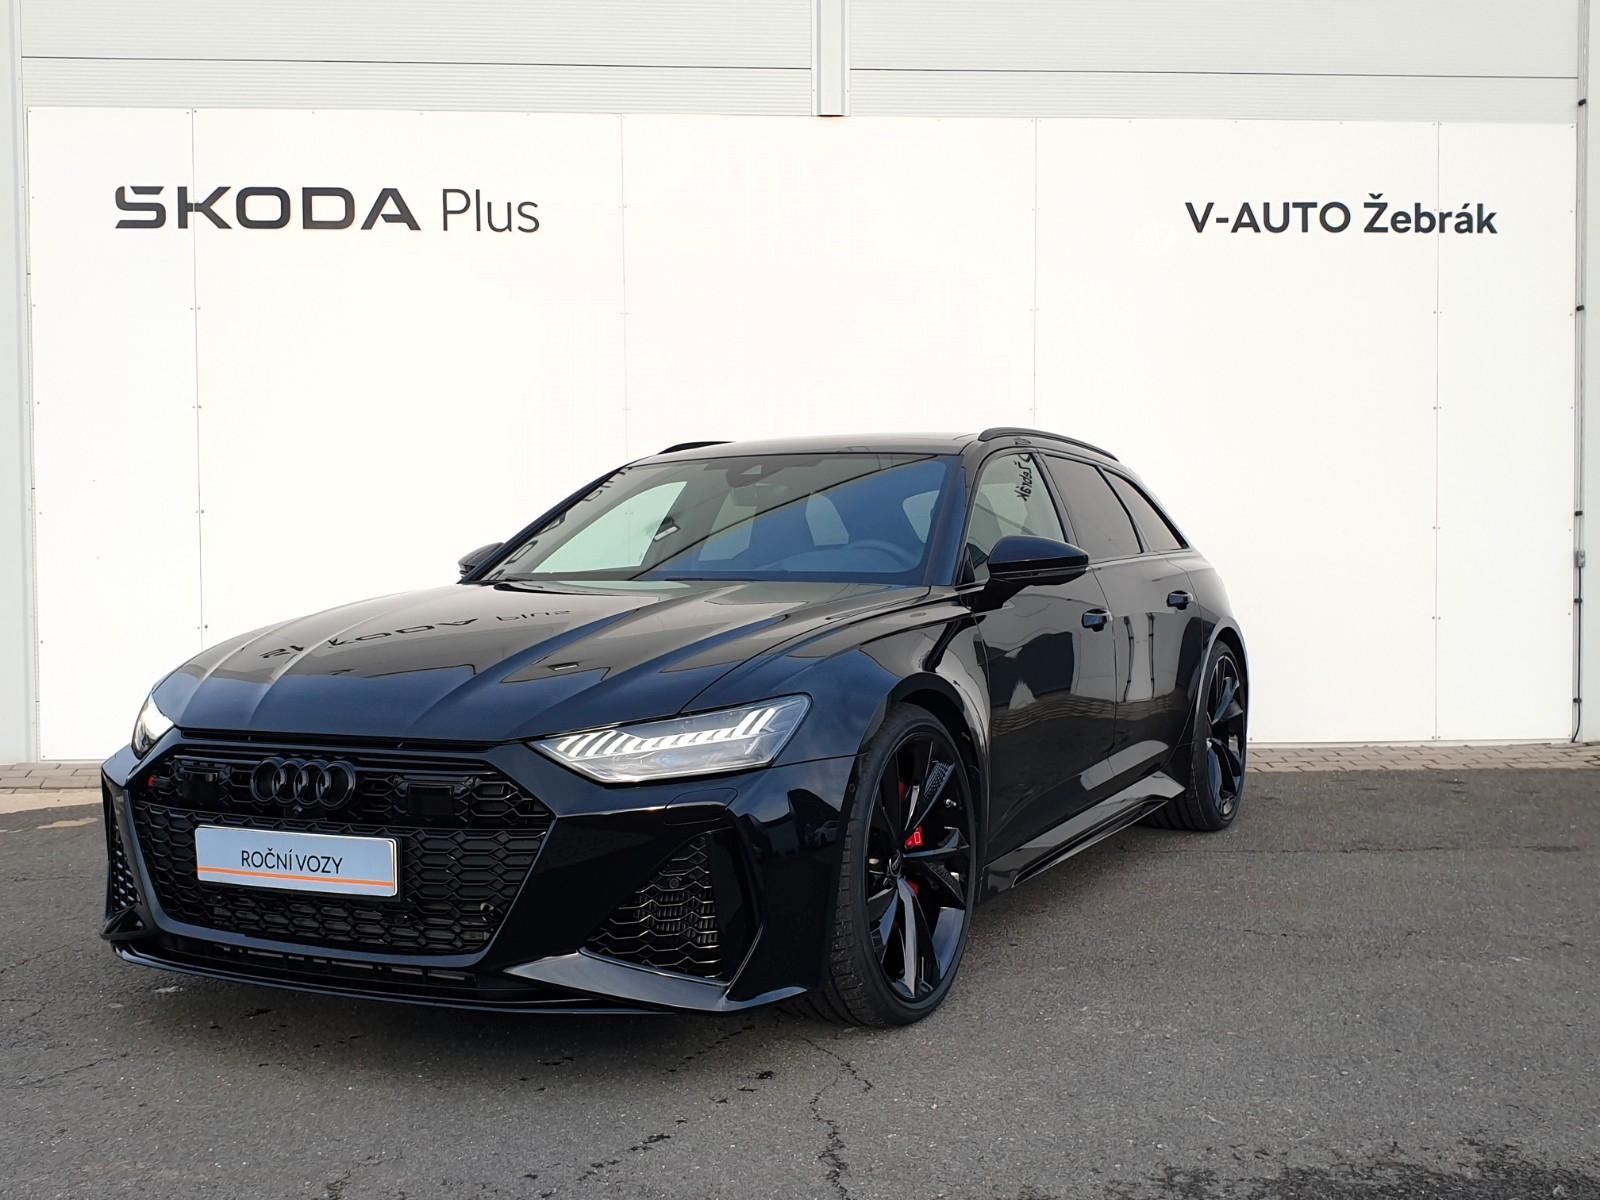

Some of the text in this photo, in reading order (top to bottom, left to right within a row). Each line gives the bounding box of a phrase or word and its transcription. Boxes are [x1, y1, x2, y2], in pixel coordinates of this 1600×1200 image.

[442, 188, 540, 233] Plus
[1185, 193, 1498, 234] V-AUTO Žebrák
[241, 848, 343, 875] ROČNÍ VOZY
